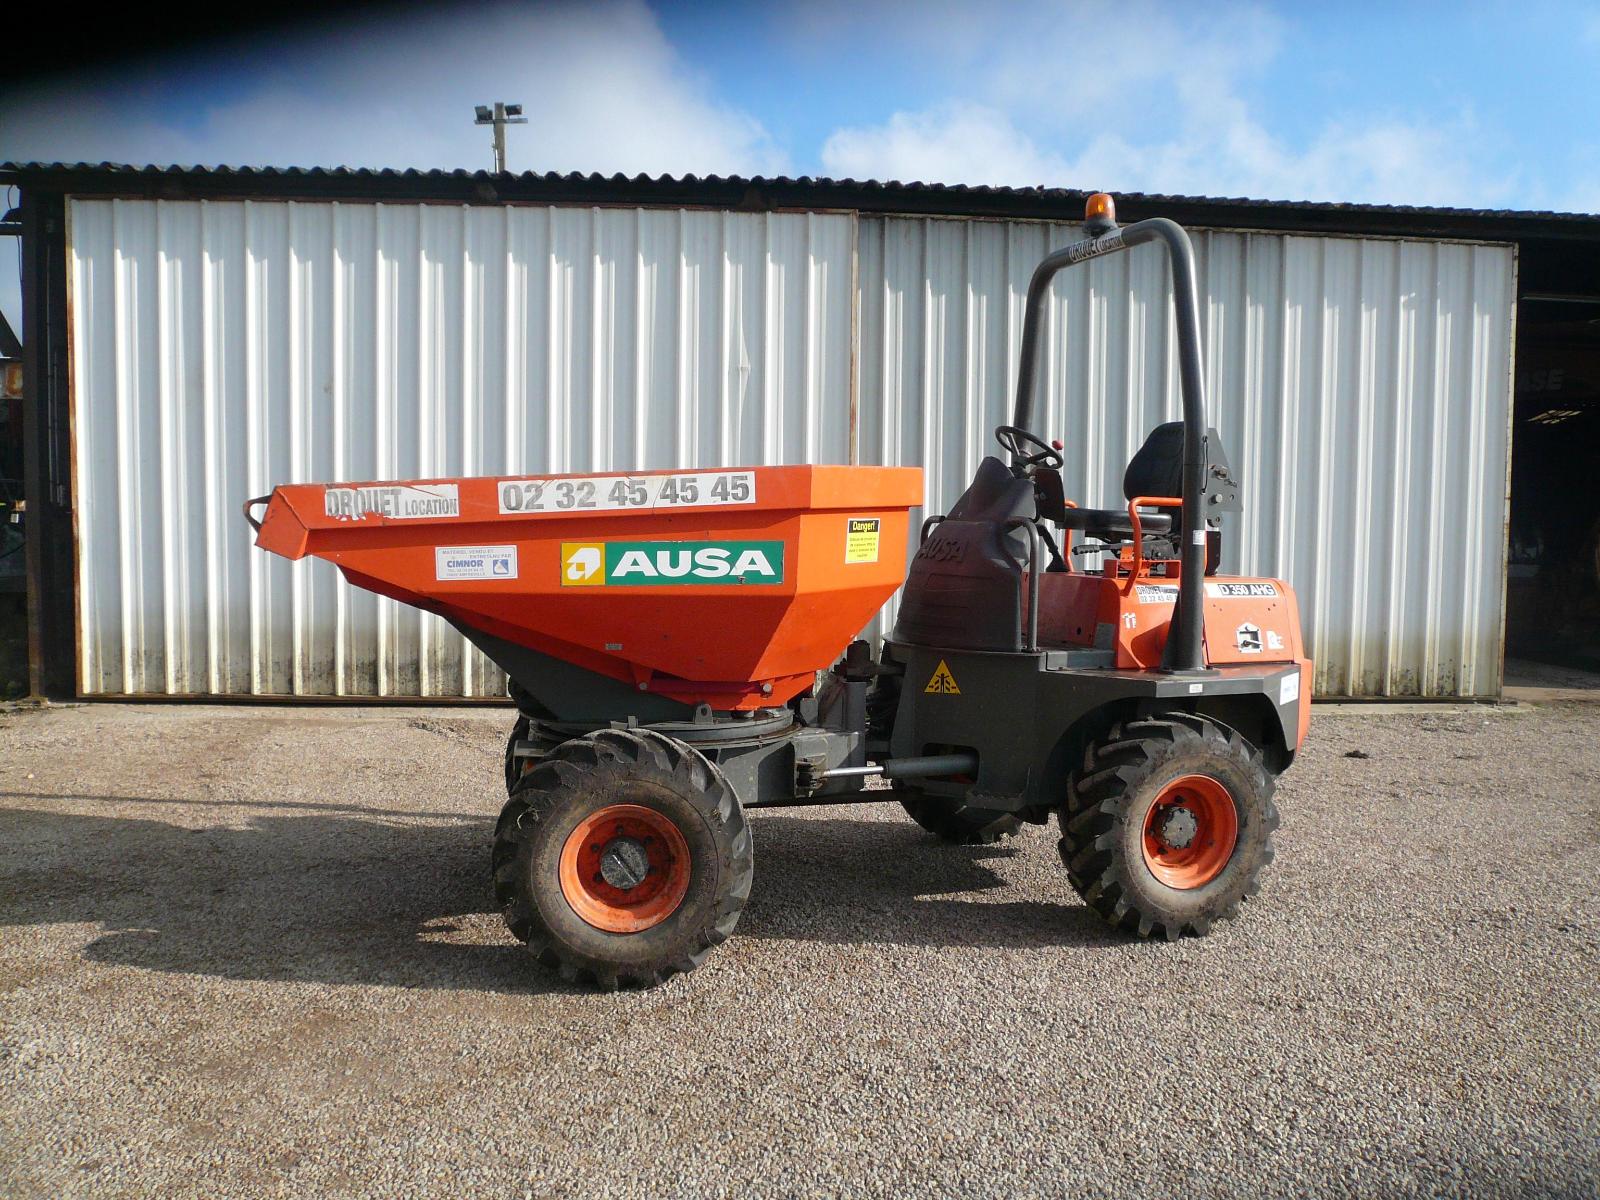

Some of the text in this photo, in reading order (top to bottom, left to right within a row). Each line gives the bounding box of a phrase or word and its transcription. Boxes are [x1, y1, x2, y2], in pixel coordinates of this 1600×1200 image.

[502, 474, 750, 511] 02 32 45 45 45
[405, 498, 458, 516] LOCATION
[446, 560, 484, 568] CIMNOR
[611, 548, 776, 578] AUSA
[1218, 584, 1275, 595] D 350 AHG
